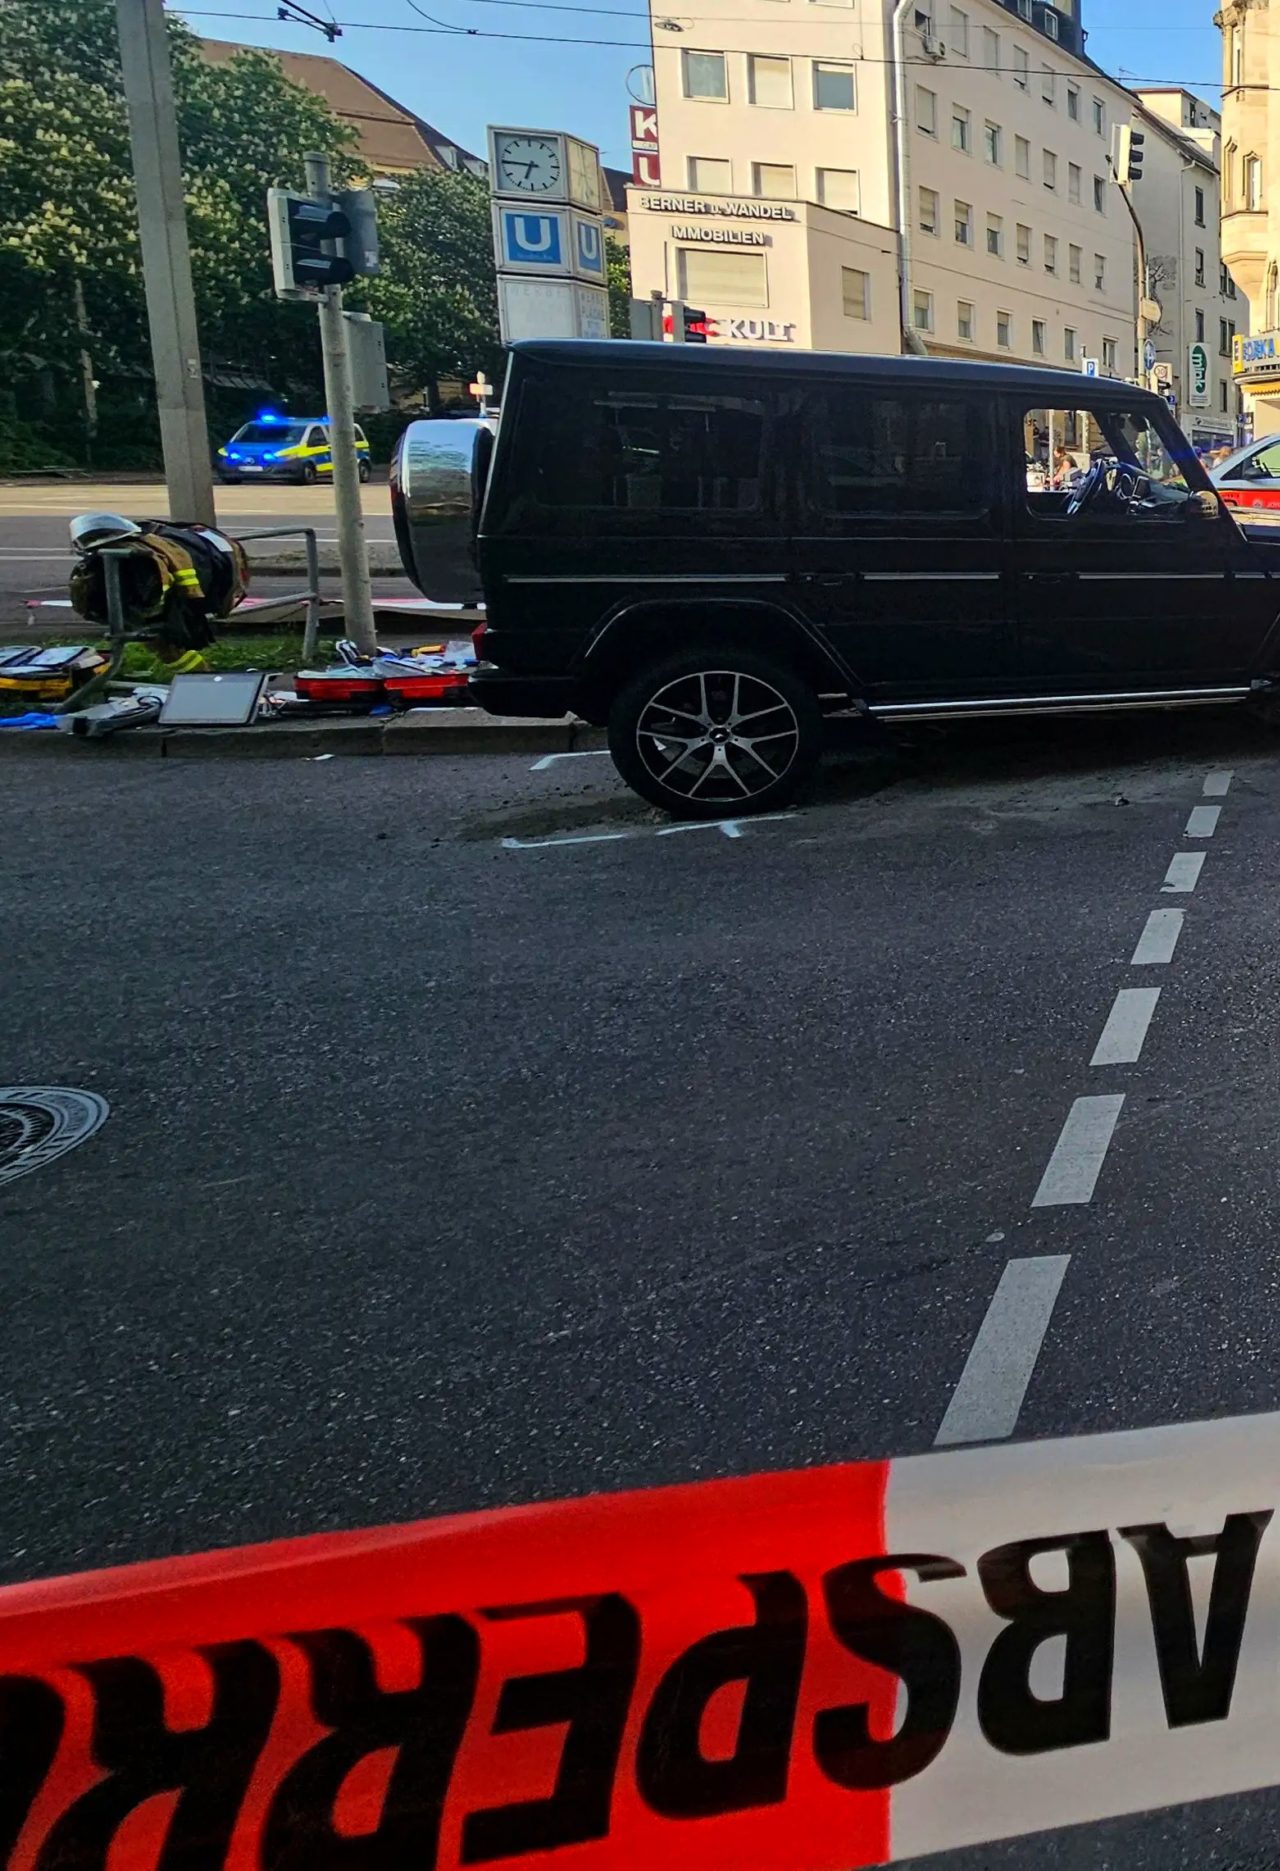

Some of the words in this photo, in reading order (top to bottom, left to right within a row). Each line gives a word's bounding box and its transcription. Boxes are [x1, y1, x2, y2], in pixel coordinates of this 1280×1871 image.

[640, 196, 706, 213] BERNER
[726, 202, 794, 220] WANDEL
[514, 216, 552, 252] U
[580, 223, 597, 260] U
[669, 225, 765, 244] MMOBILIEN
